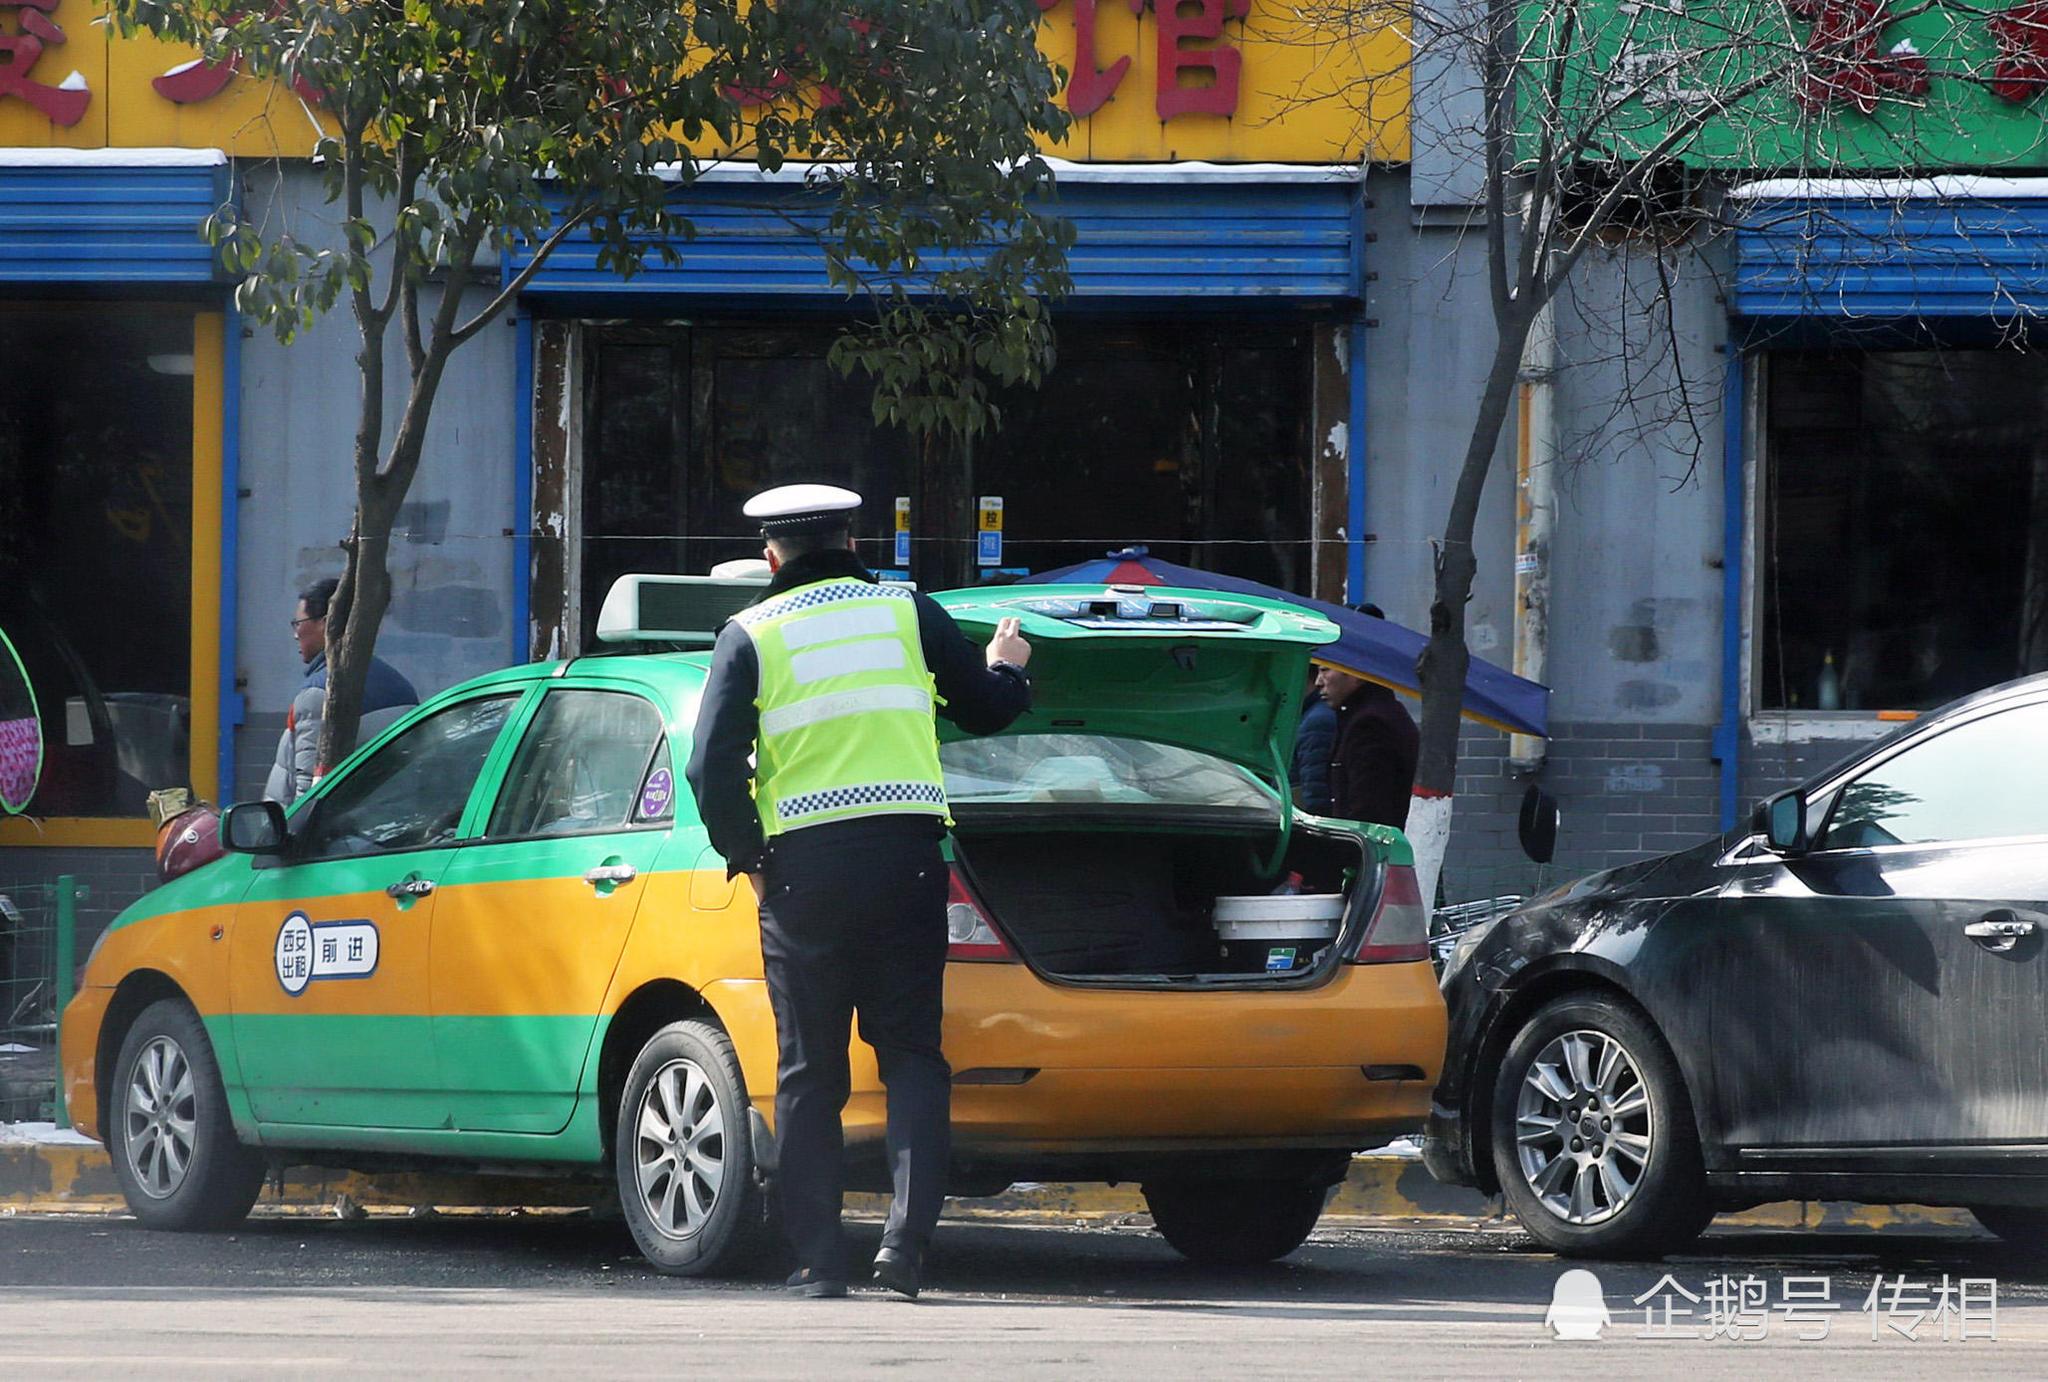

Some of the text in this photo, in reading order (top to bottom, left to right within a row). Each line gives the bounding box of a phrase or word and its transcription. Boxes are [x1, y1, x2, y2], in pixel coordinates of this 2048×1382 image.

[283, 929, 307, 952] 西安
[321, 936, 363, 963] 前进
[282, 955, 306, 979] 出租
